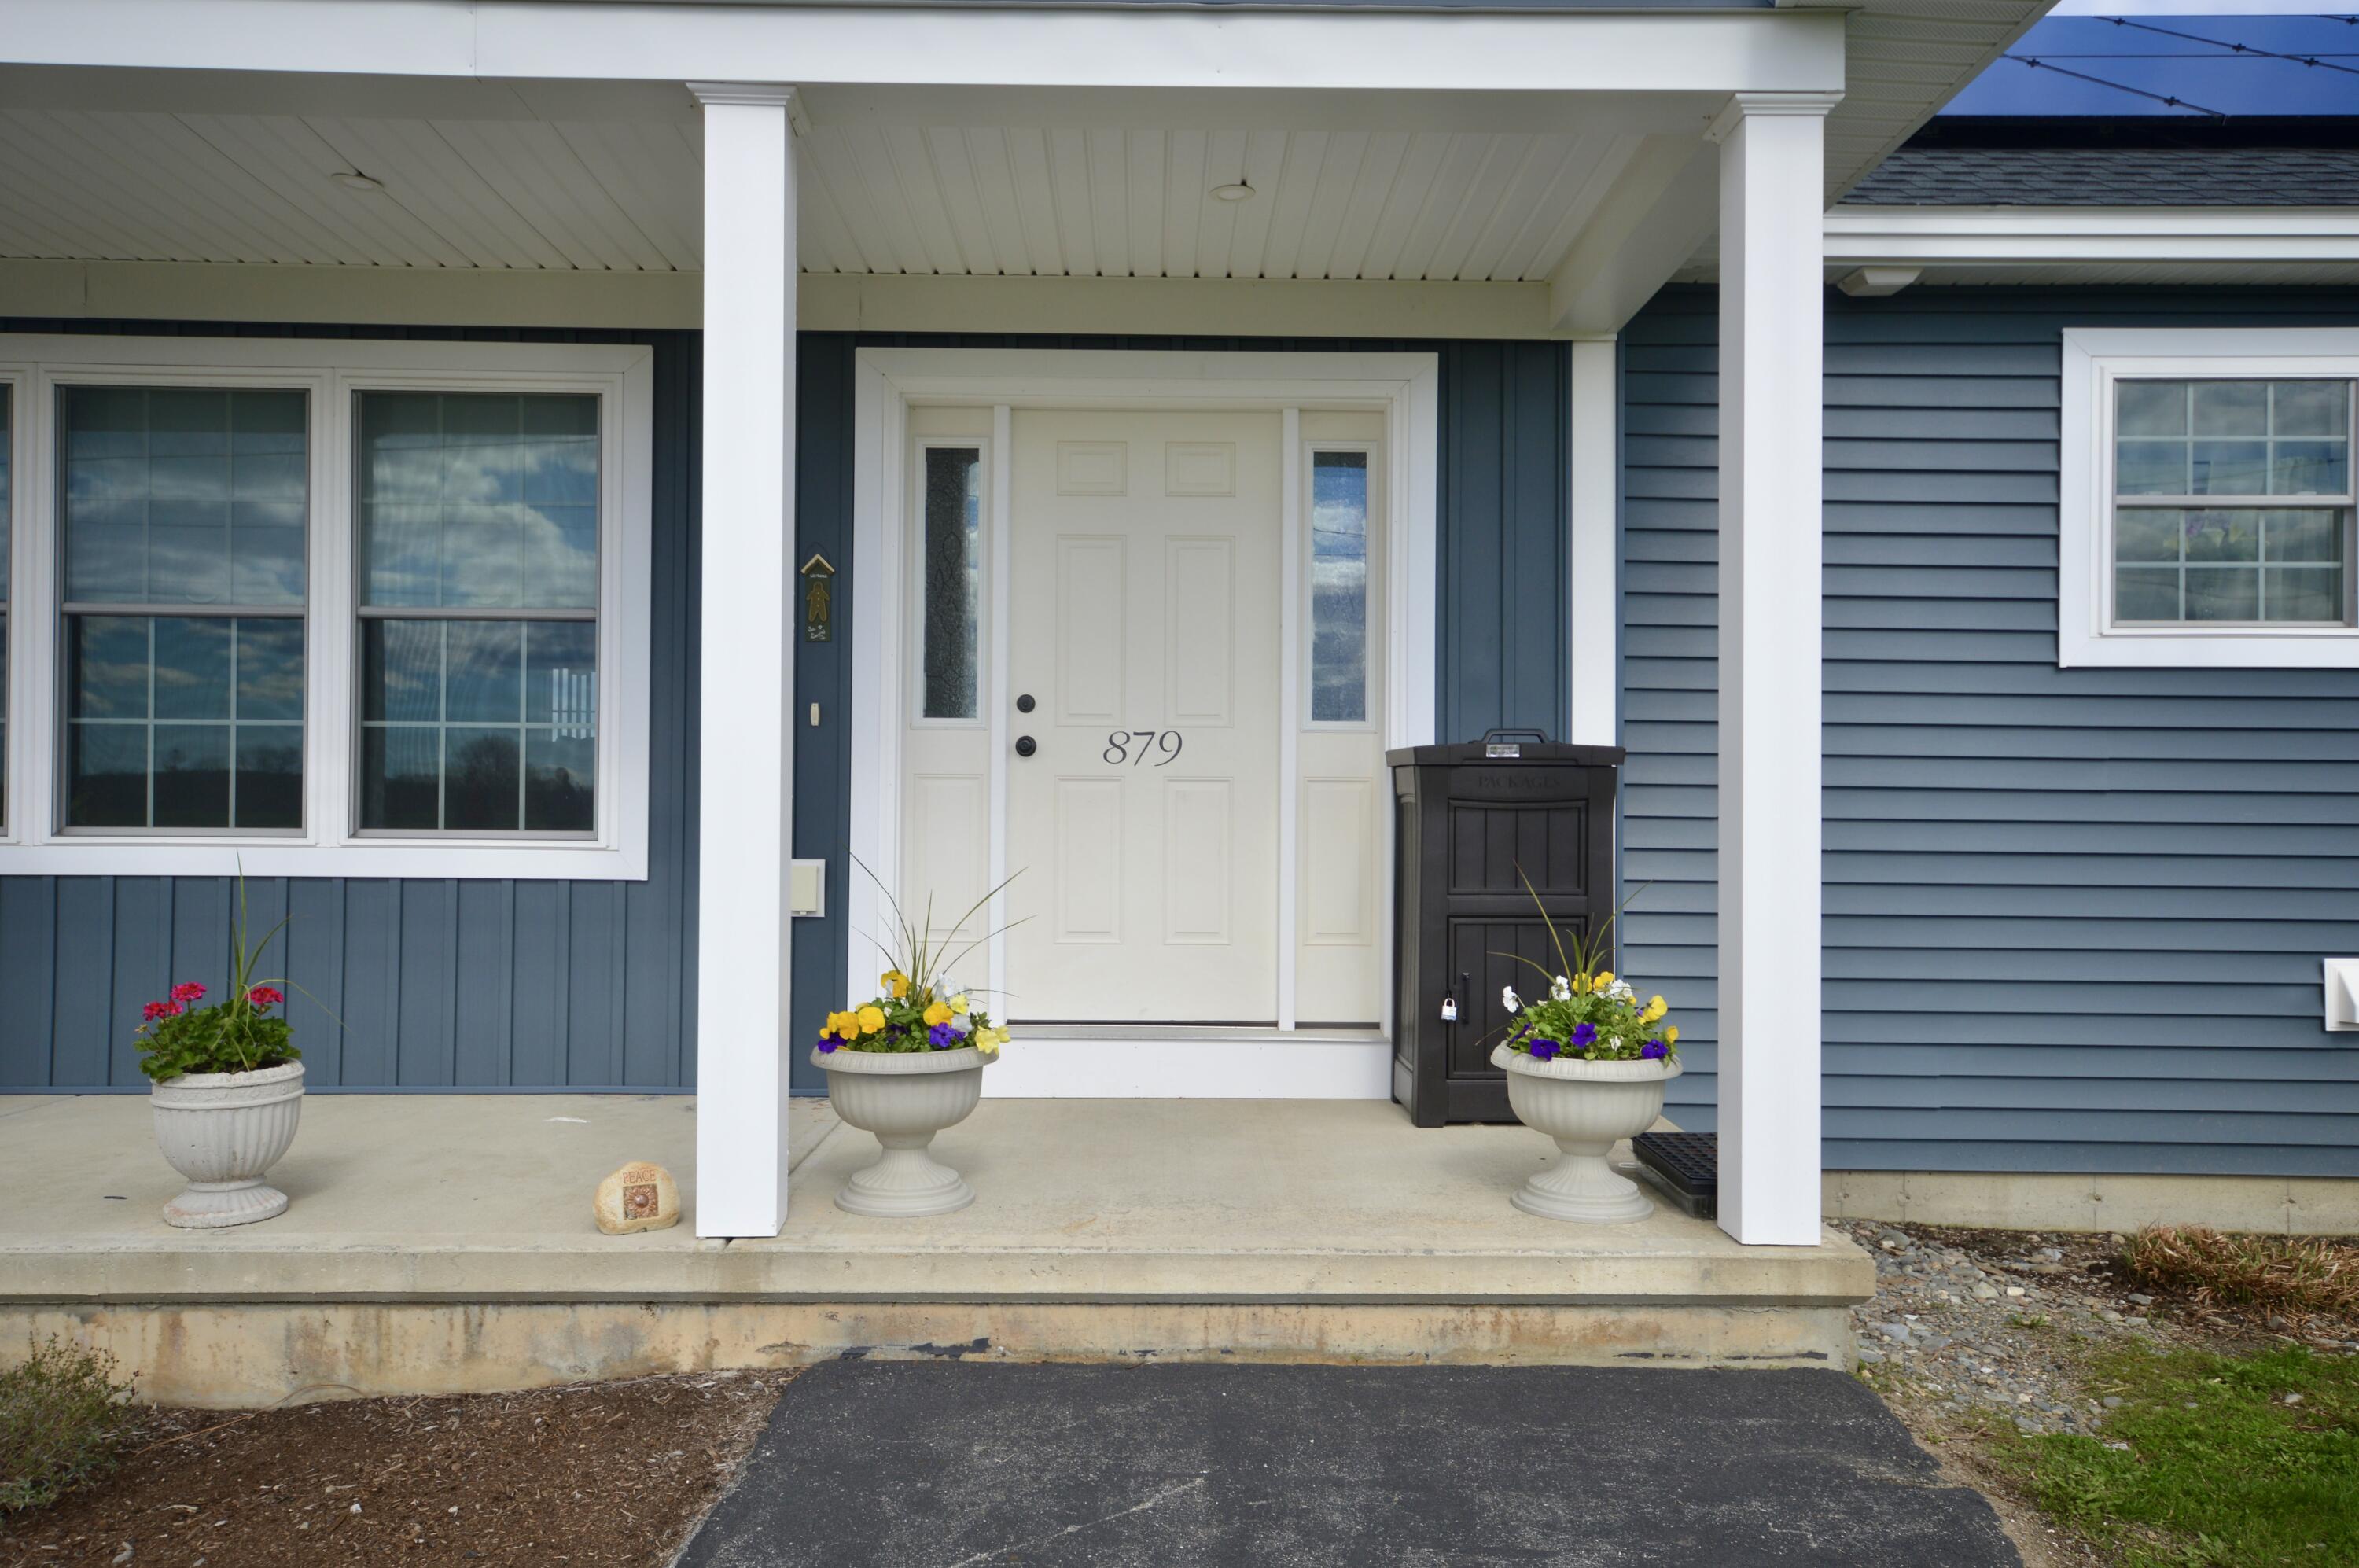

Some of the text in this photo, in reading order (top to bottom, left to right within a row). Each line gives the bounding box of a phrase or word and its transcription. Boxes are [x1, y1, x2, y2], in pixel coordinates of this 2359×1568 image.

[1102, 731, 1183, 767] 879
[1478, 774, 1561, 789] PACKAGES
[622, 1169, 657, 1184] PEACE
